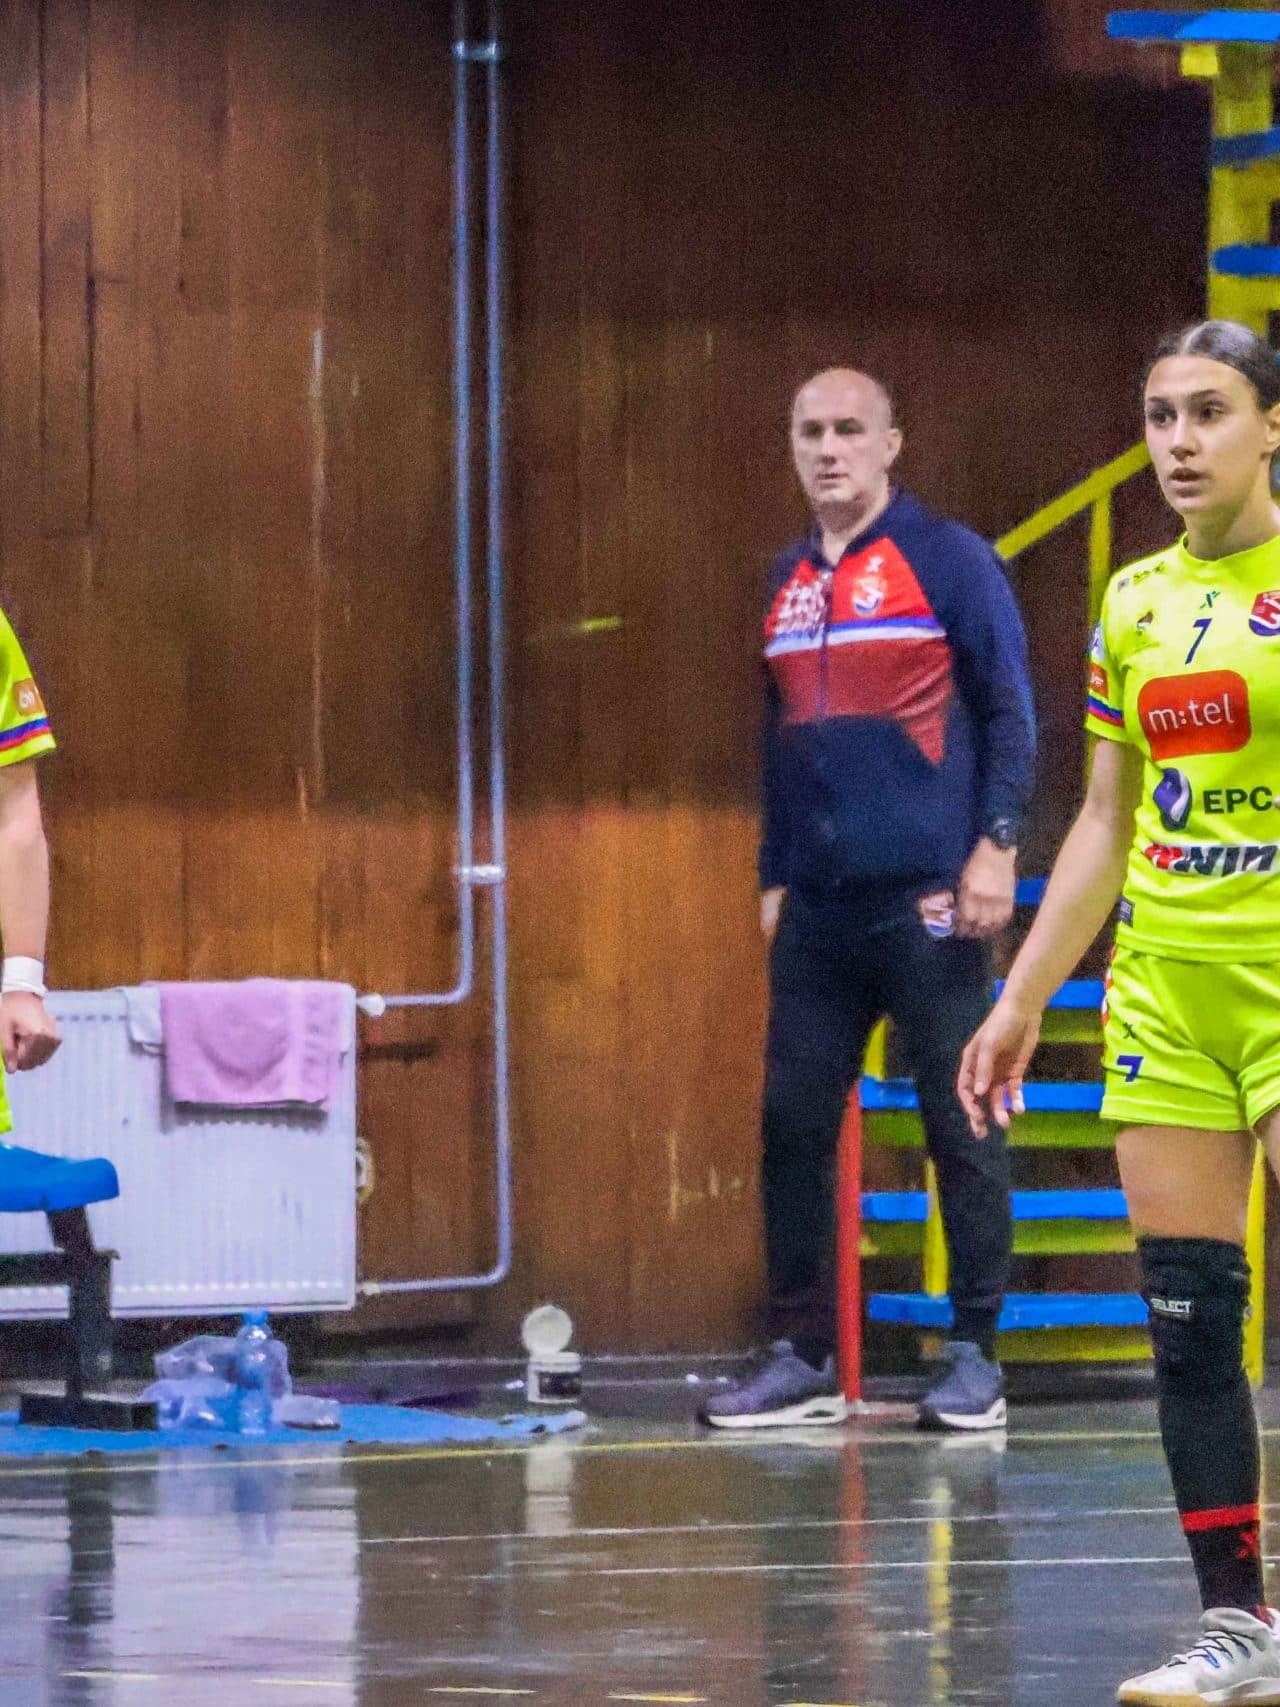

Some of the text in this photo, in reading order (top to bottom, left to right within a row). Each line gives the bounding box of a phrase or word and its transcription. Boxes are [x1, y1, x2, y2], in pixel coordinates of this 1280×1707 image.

[1185, 617, 1213, 665] 7
[1148, 693, 1235, 733] m:tel
[1203, 785, 1273, 815] EPC
[1116, 1054, 1144, 1083] 7
